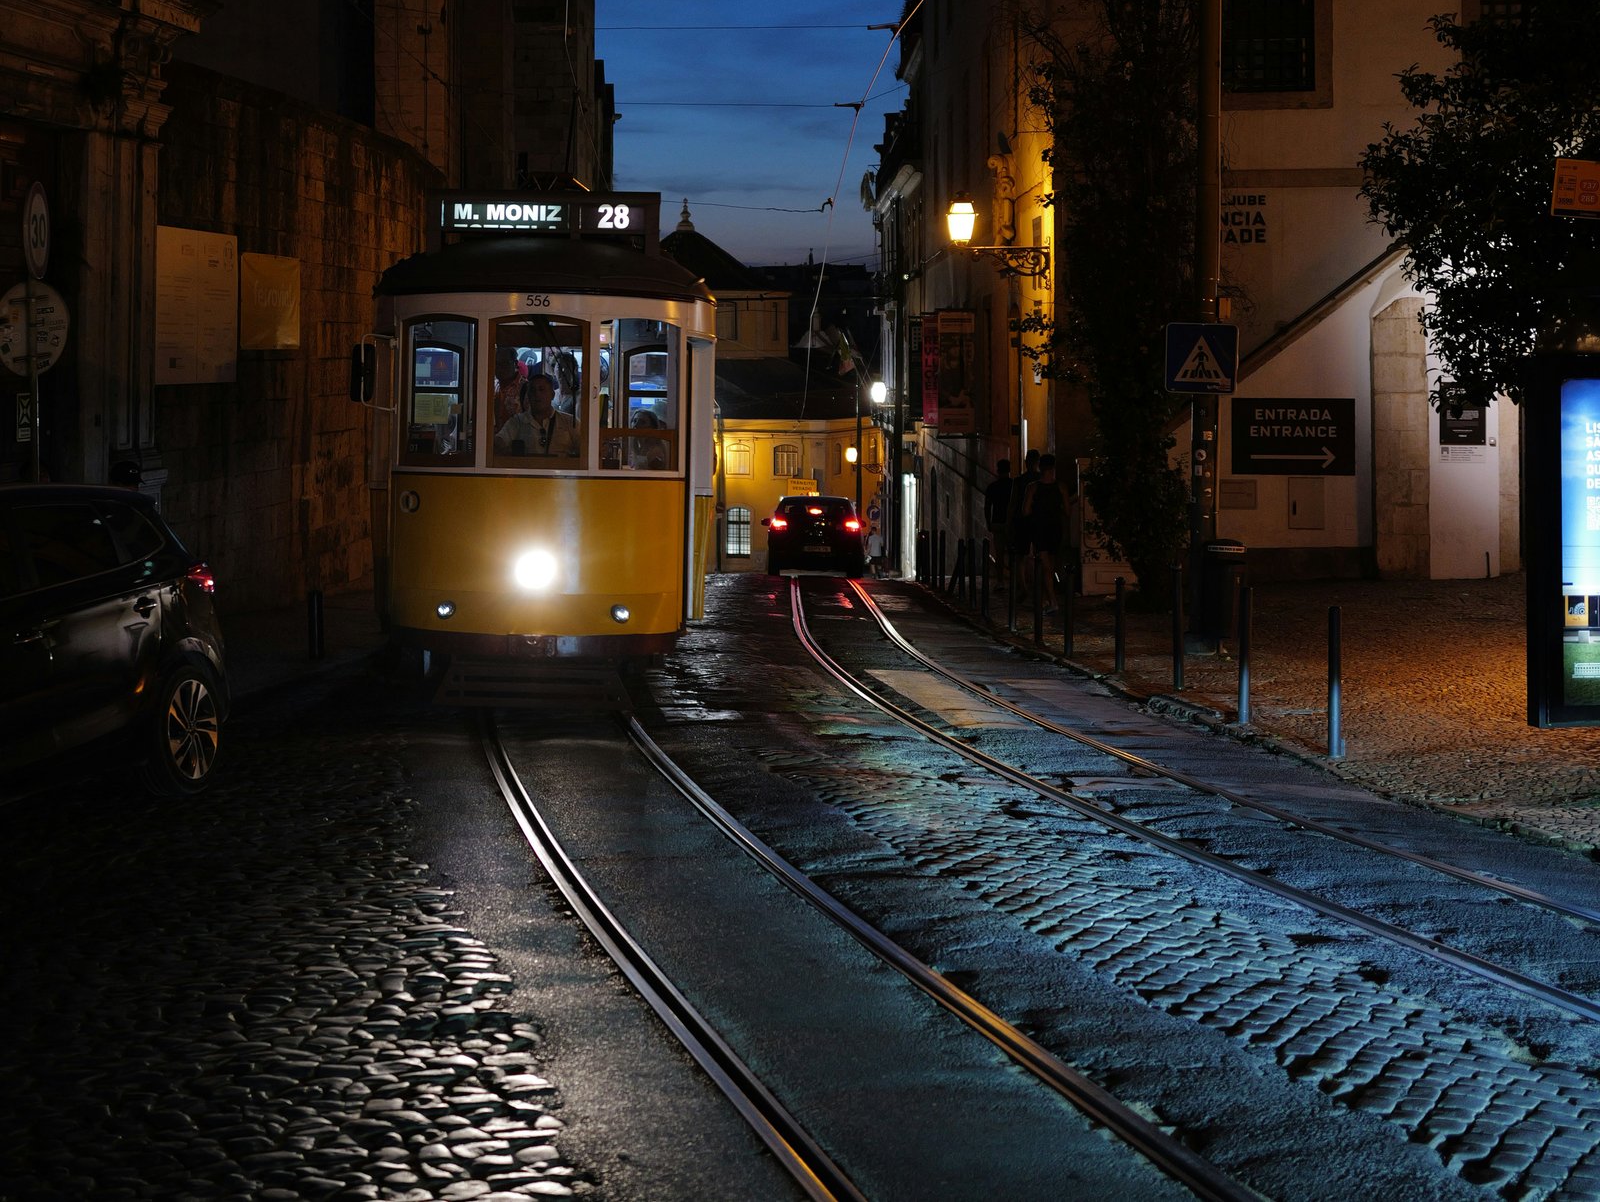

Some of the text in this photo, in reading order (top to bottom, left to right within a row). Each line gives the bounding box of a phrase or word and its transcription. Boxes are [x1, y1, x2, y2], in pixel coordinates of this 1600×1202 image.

[454, 204, 562, 222] M. MONIZ
[597, 204, 630, 230] 28
[31, 213, 46, 248] 30
[1220, 228, 1266, 243] ADE
[526, 294, 550, 307] 556
[1255, 408, 1332, 420] ENTRADA
[1249, 425, 1337, 437] ENTRANCE
